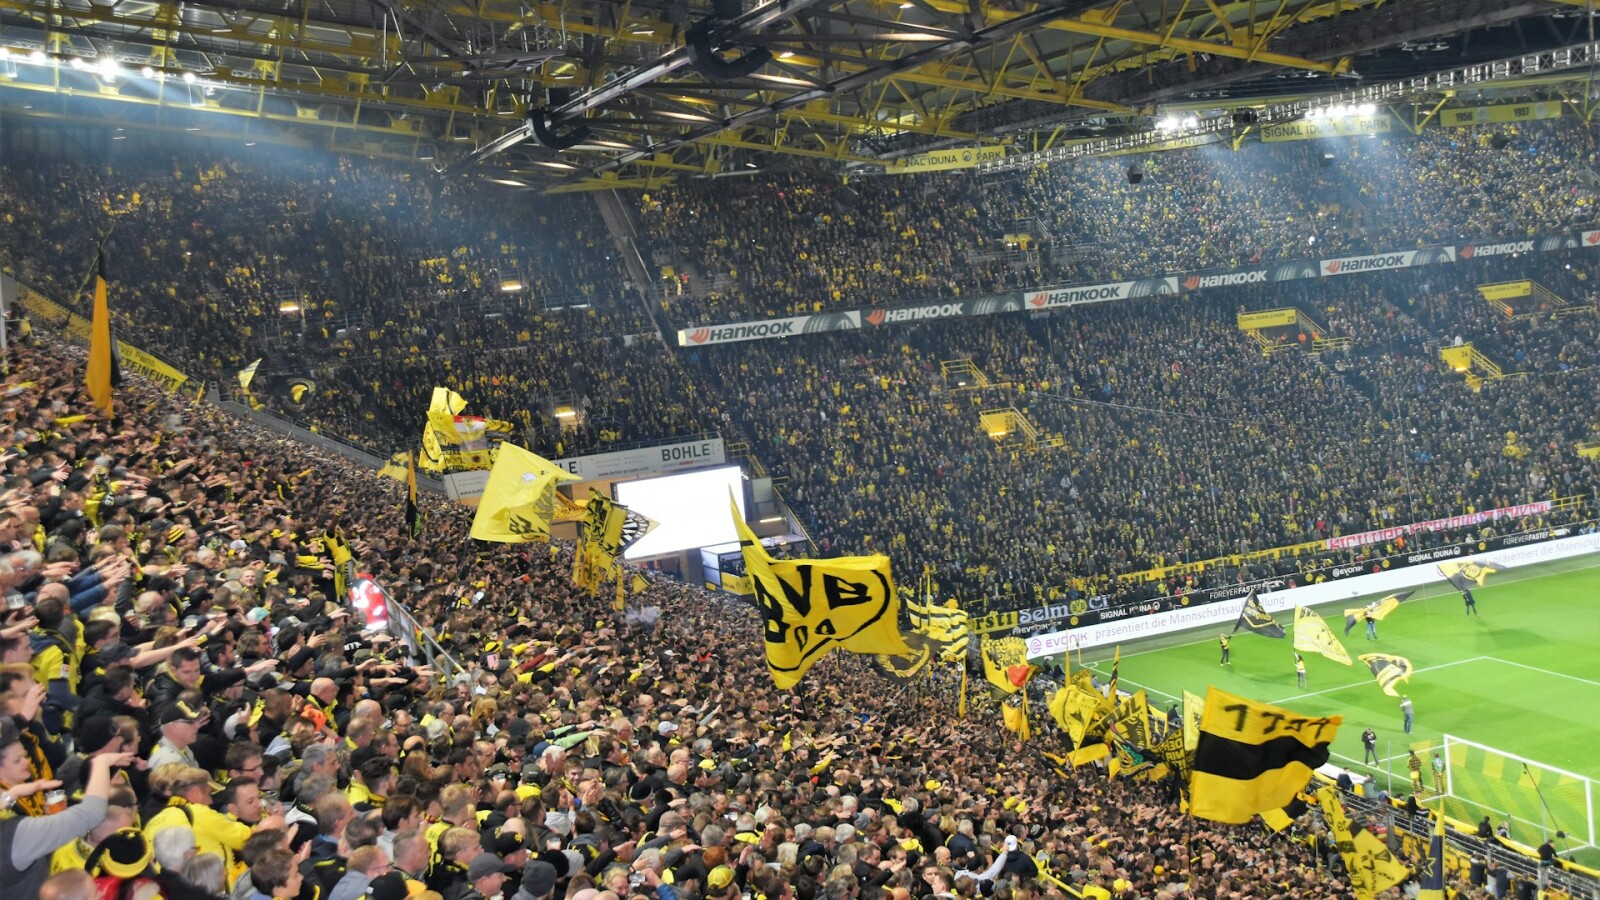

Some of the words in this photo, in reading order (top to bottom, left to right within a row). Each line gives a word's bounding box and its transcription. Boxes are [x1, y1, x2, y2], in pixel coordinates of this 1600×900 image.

[1264, 126, 1303, 138] SIGNAL
[1360, 119, 1389, 130] PARK
[928, 155, 958, 165] IDUNA
[662, 443, 711, 462] BOHLE
[1408, 553, 1432, 564] SIGNAL
[1433, 549, 1453, 560] IDUNA
[1100, 608, 1128, 620] SIGNAL
[1045, 632, 1088, 649] EVONIK
[1095, 620, 1149, 639] präsentiert
[1152, 615, 1167, 629] die
